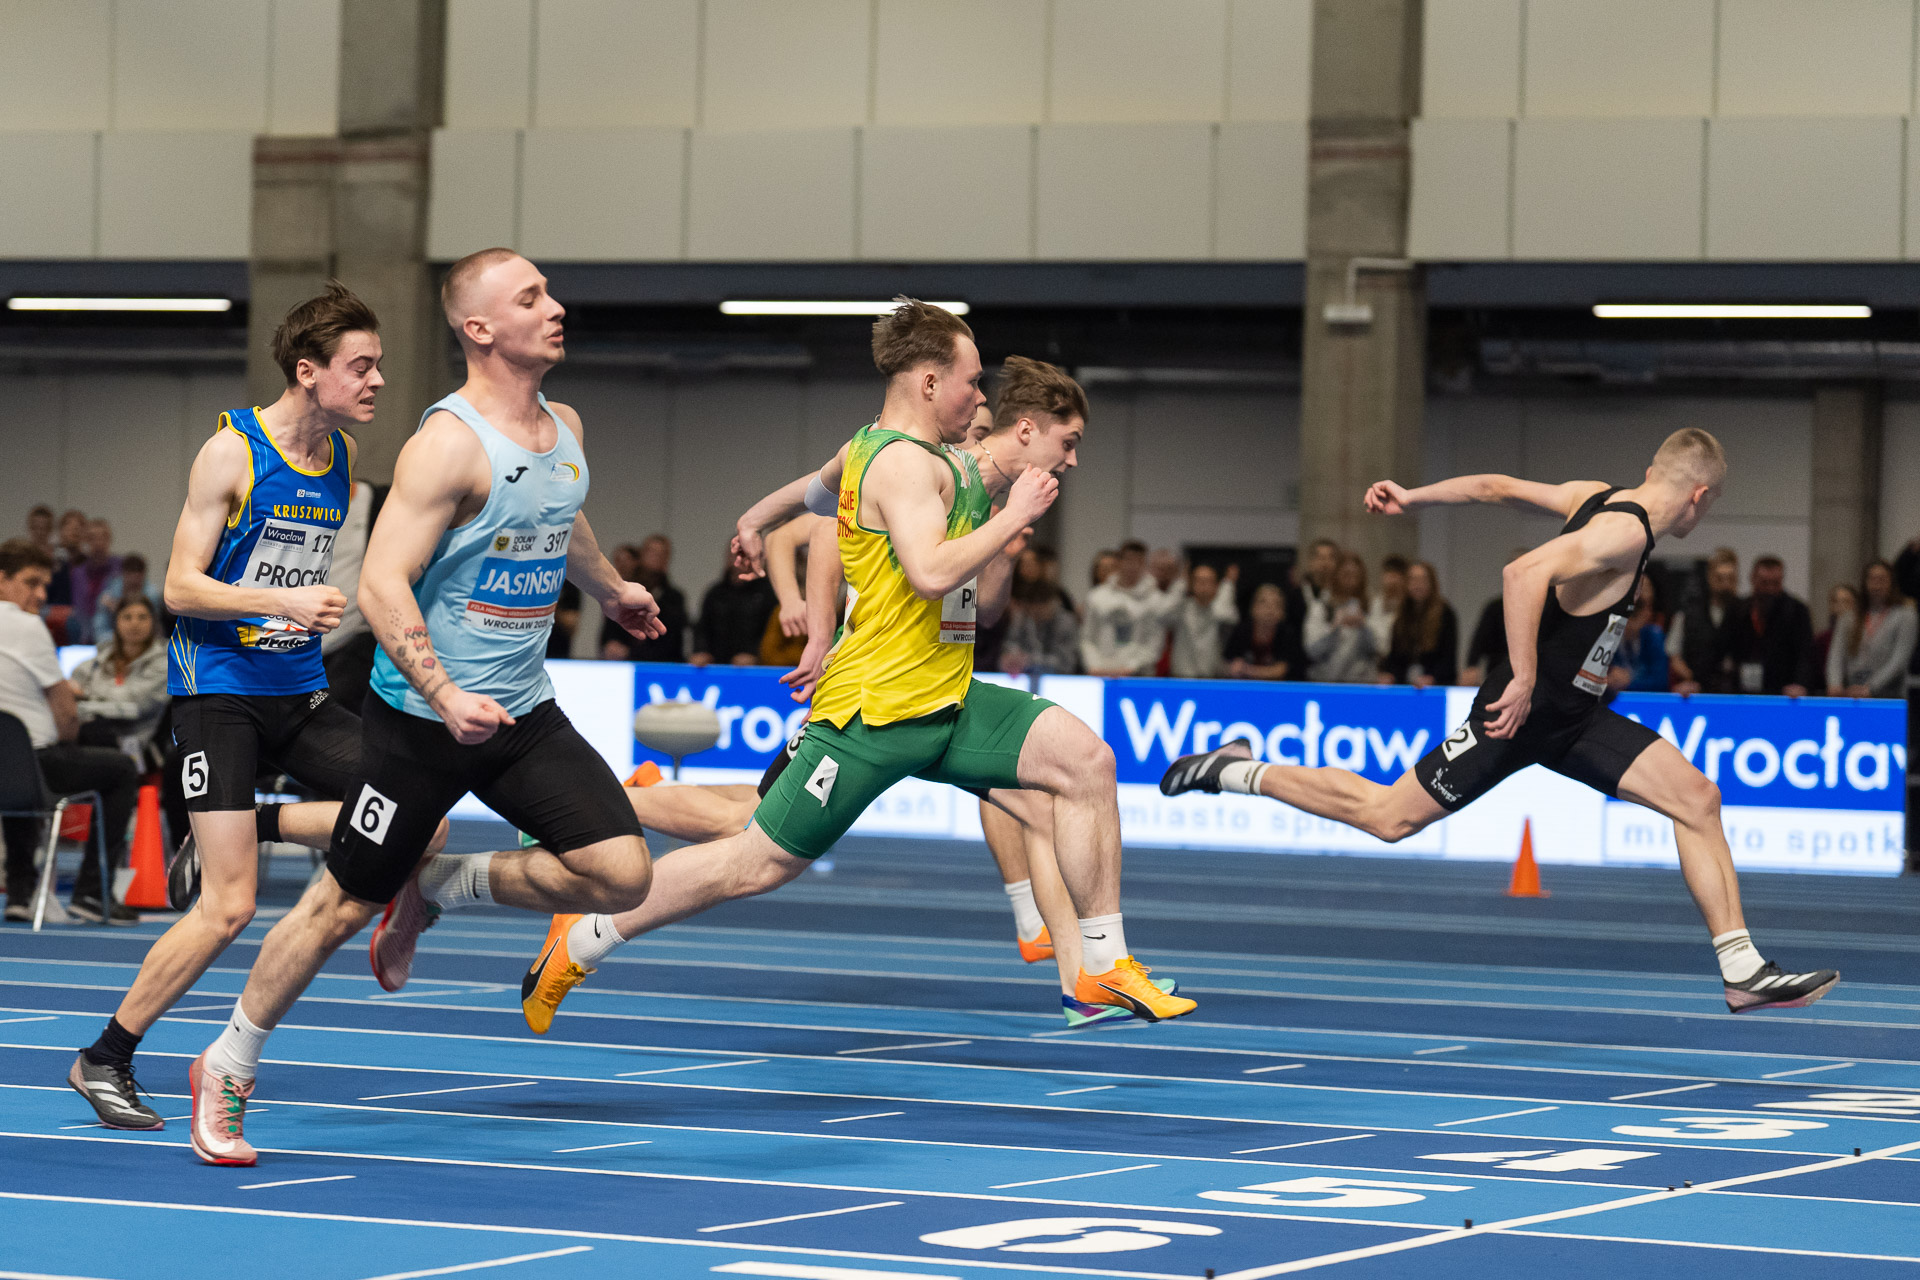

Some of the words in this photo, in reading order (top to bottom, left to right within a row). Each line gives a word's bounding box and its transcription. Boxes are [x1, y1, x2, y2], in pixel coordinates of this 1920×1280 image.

[273, 504, 342, 522] KRUSZWICA
[312, 534, 333, 554] 17
[513, 535, 537, 544] DOLNY
[544, 530, 568, 553] 397
[254, 561, 328, 589] PROCEK
[480, 566, 565, 595] JASIŃSKI
[483, 618, 534, 630] WROCŁAW
[1119, 697, 1430, 774] Wrocław
[1445, 728, 1469, 753] 2
[1626, 714, 1906, 792] Wrocła
[188, 756, 206, 793] 5
[360, 796, 385, 834] 6
[1623, 820, 1765, 853] mito
[1610, 1116, 1830, 1140] 3
[1413, 1148, 1661, 1172] 4
[1196, 1176, 1476, 1209] 5
[918, 1216, 1224, 1254] 6
